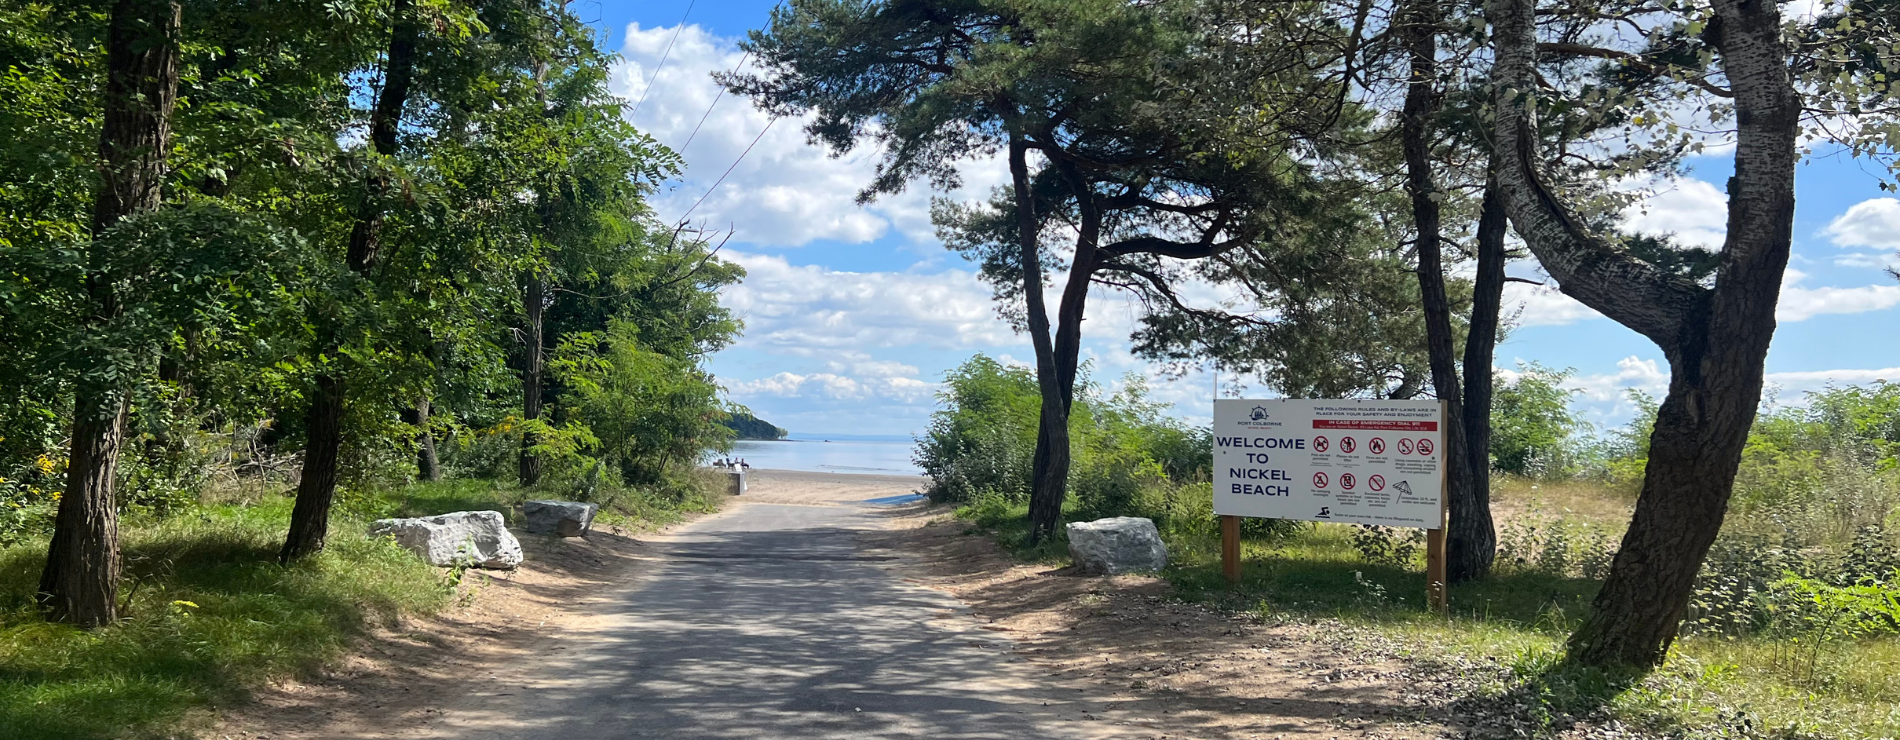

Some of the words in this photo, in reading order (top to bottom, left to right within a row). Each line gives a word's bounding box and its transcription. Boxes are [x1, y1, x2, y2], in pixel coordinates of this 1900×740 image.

[1216, 436, 1305, 449] WELCOME
[1246, 453, 1269, 464] TO
[1230, 468, 1292, 481] NICKEL
[1232, 483, 1289, 497] BEACH
